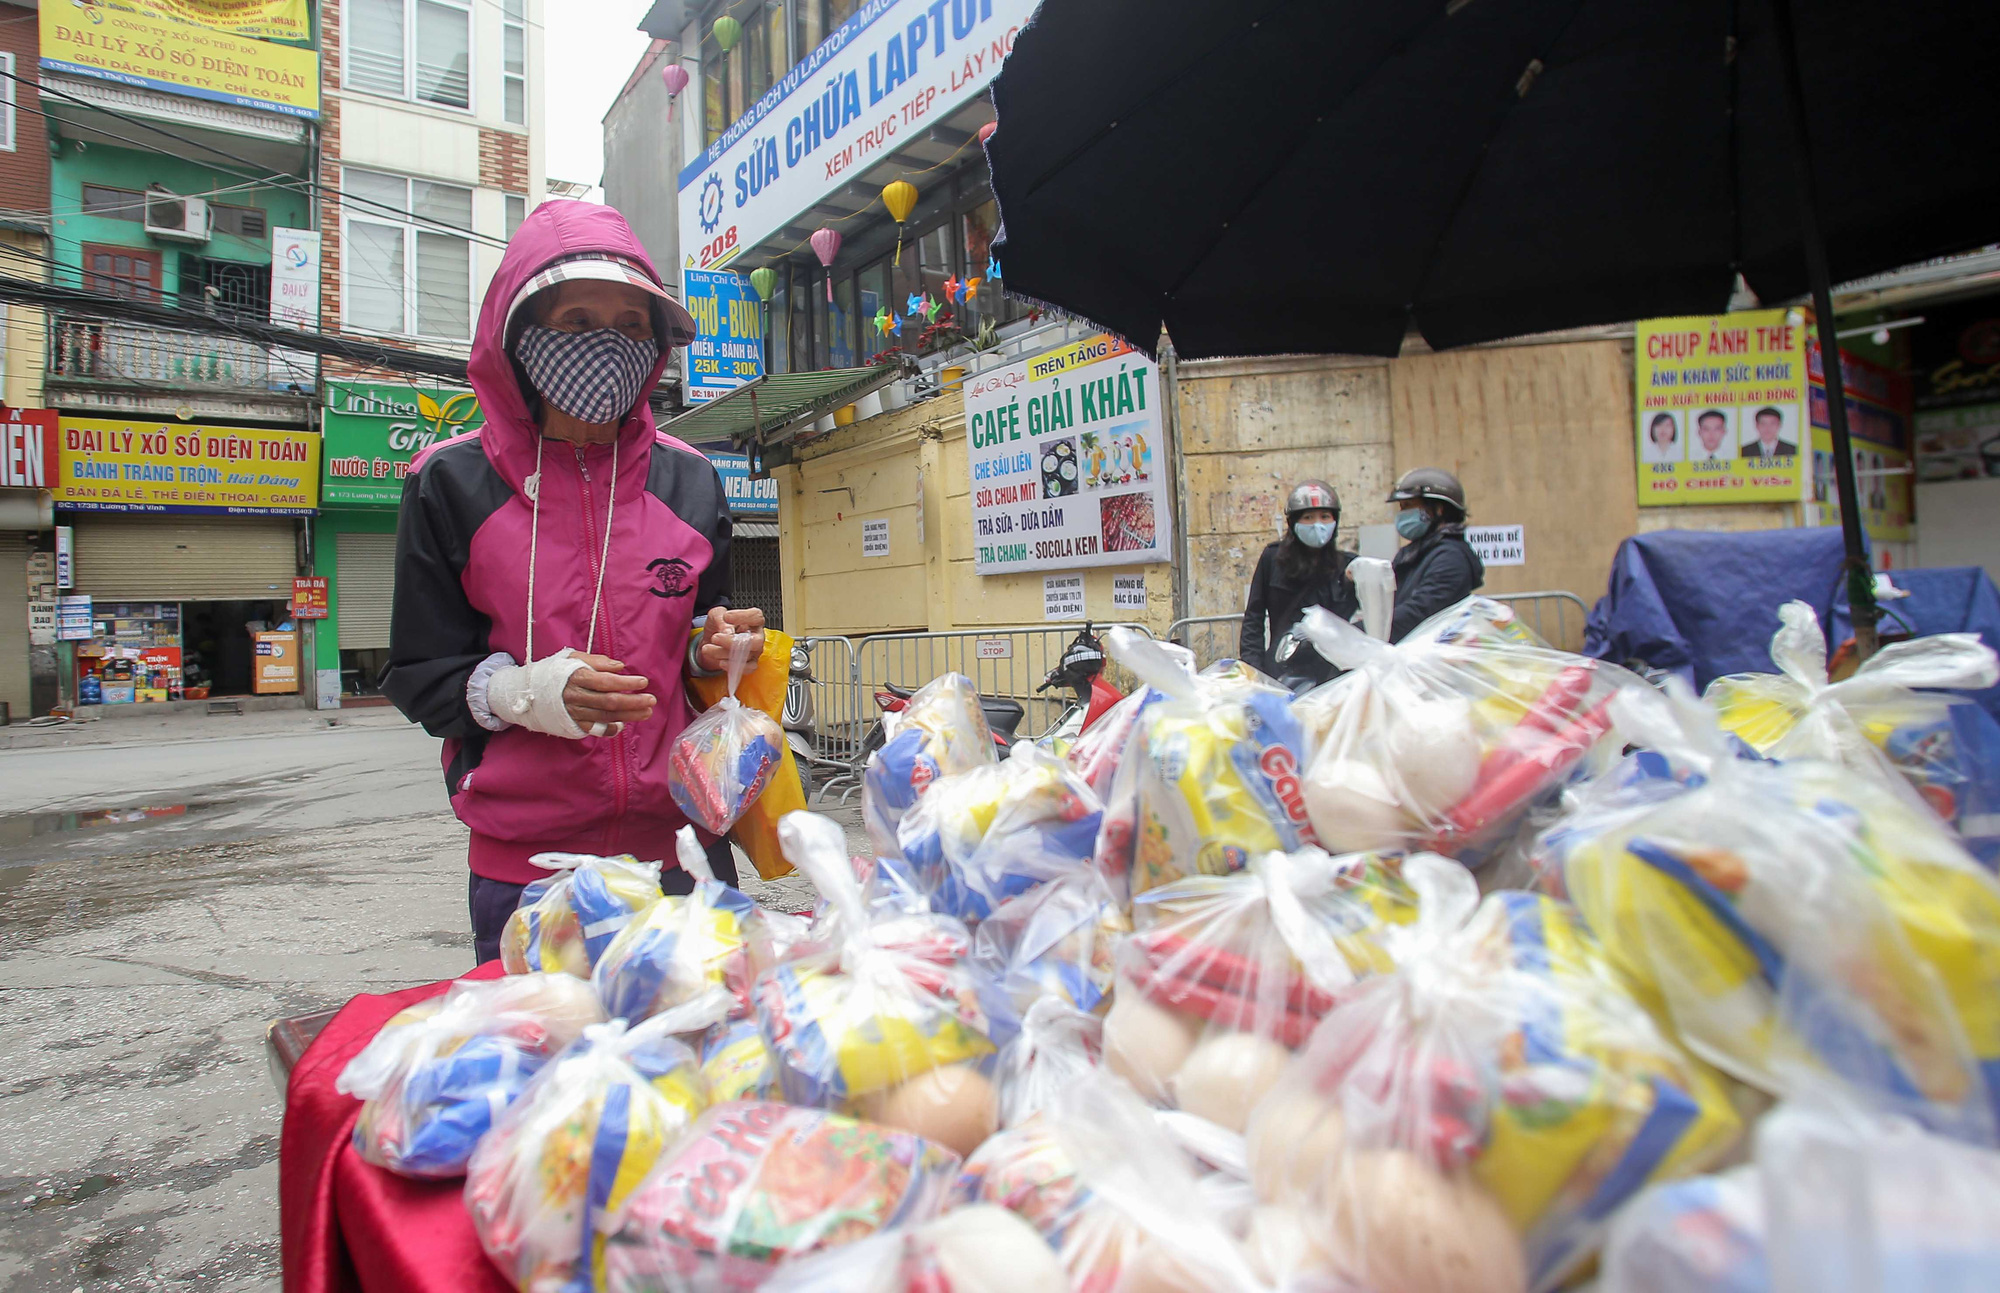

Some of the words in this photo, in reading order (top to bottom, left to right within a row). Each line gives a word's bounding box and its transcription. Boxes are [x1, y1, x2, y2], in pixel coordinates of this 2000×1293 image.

[112, 19, 147, 32] CÔNG
[151, 27, 167, 37] TY
[55, 24, 96, 47] ĐẠI
[101, 35, 128, 53] LÝ
[135, 38, 165, 60] XỔ
[170, 48, 195, 67] SỐ
[202, 57, 249, 78] ĐIỆN
[254, 67, 306, 88] TOÁN
[147, 68, 177, 80] BIỆT
[274, 92, 291, 102] 5K
[756, 84, 782, 118] DỊCH
[782, 68, 798, 92] VỤ
[801, 24, 849, 78] LAPTOP
[253, 100, 275, 110] 0382
[278, 104, 294, 114] 113
[295, 108, 313, 117] 403
[734, 134, 780, 208] SỬA
[785, 70, 862, 168] CHỮA
[868, 0, 992, 107] LAPTO
[825, 145, 853, 181] XEM
[856, 114, 897, 157] TRỰC
[900, 86, 936, 127] TIẾP
[951, 47, 986, 92] LẤY
[699, 225, 738, 268] 208
[690, 272, 710, 284] Linh
[712, 275, 728, 284] Chi
[688, 284, 719, 337] PHỞ
[729, 291, 760, 340] BÚN
[691, 338, 714, 356] MIẾN
[721, 340, 745, 359] BÁNH
[1647, 331, 1701, 363] CHỤP
[1708, 321, 1749, 355] ẢNH
[695, 359, 720, 374] 25K
[732, 361, 757, 376] 30K
[1033, 357, 1065, 377] TRÊN
[1068, 342, 1108, 366] TẦNG
[1111, 338, 1120, 351] 2
[1652, 364, 1678, 387] ẢNH
[1725, 362, 1751, 382] SỨC
[971, 395, 1021, 449] CAFÉ
[1027, 377, 1074, 437] GIẢI
[1080, 363, 1148, 424] KHÁT
[1740, 391, 1762, 402] LAO
[66, 429, 102, 456] ĐẠI
[110, 428, 133, 454] LÝ
[140, 426, 168, 455] XỔ
[174, 429, 201, 457] SỐ
[207, 434, 252, 463] ĐIỆN
[258, 437, 307, 462] TOÁN
[389, 422, 437, 450] Trà
[73, 458, 118, 480] BÁNH
[122, 461, 174, 482] TRÁNG
[178, 464, 222, 487] TRỘN:
[330, 456, 368, 478] NƯỚC
[372, 457, 390, 478] ÉP
[975, 459, 990, 480] CHÈ
[993, 452, 1010, 477] SẦU
[1012, 451, 1032, 473] LIÊN
[184, 490, 215, 501] ĐIỆN
[270, 494, 307, 504] GAME
[725, 476, 752, 498] NEM
[977, 487, 993, 508] SỮA
[995, 485, 1018, 505] CHUA
[1020, 479, 1036, 501] MÍT
[978, 515, 994, 536] TRÀ
[996, 512, 1013, 534] SỮA
[1021, 508, 1040, 531] DỪA
[1042, 503, 1064, 529] DẦM
[980, 543, 995, 564] TRÀ
[997, 543, 1027, 562] CHANH
[1035, 537, 1073, 559] SOCOLA
[1075, 535, 1098, 556] KEM
[1470, 531, 1504, 543] KHÔNG
[1503, 547, 1522, 559] ĐÂY
[296, 578, 310, 588] TRÀ
[1115, 578, 1135, 589] KHÔNG
[1133, 594, 1145, 604] ĐÂY
[983, 647, 1004, 655] STOP
